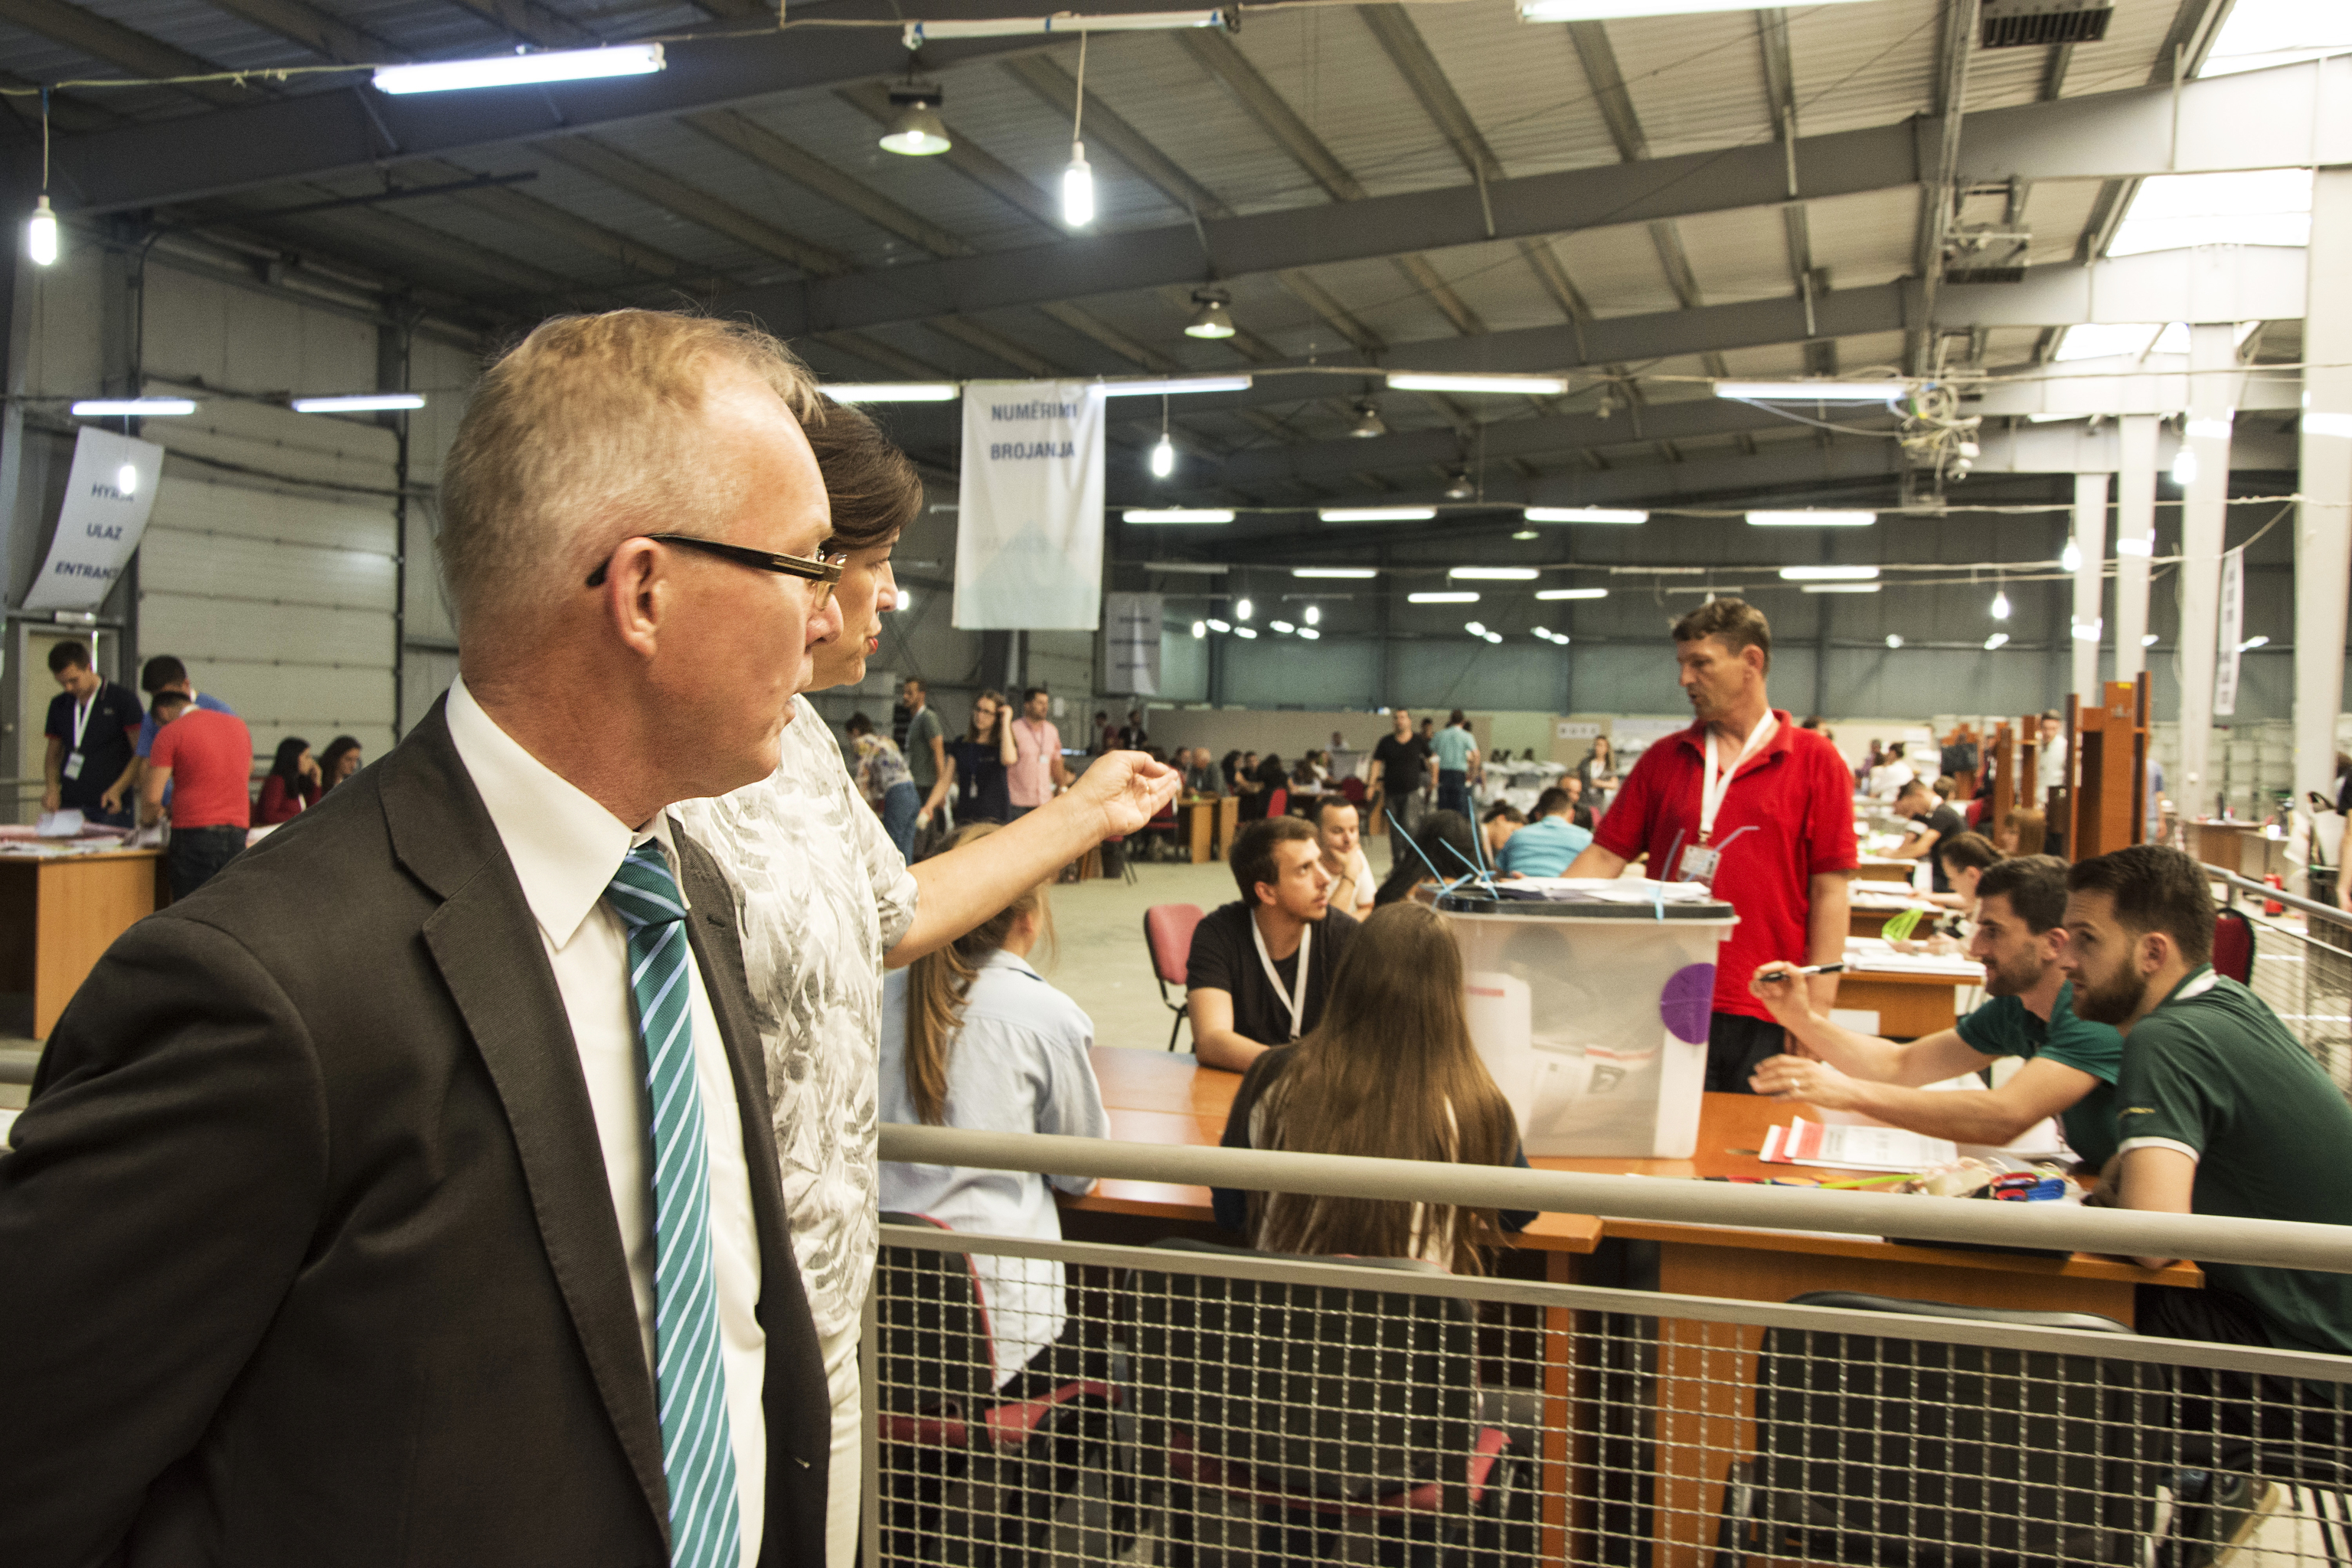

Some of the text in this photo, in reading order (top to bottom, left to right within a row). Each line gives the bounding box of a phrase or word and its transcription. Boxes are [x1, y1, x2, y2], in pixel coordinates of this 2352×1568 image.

[992, 400, 1077, 420] NUMËRIMI
[991, 442, 1074, 459] BROJANJA
[92, 482, 133, 501] HYR
[87, 524, 122, 540] ULAZ
